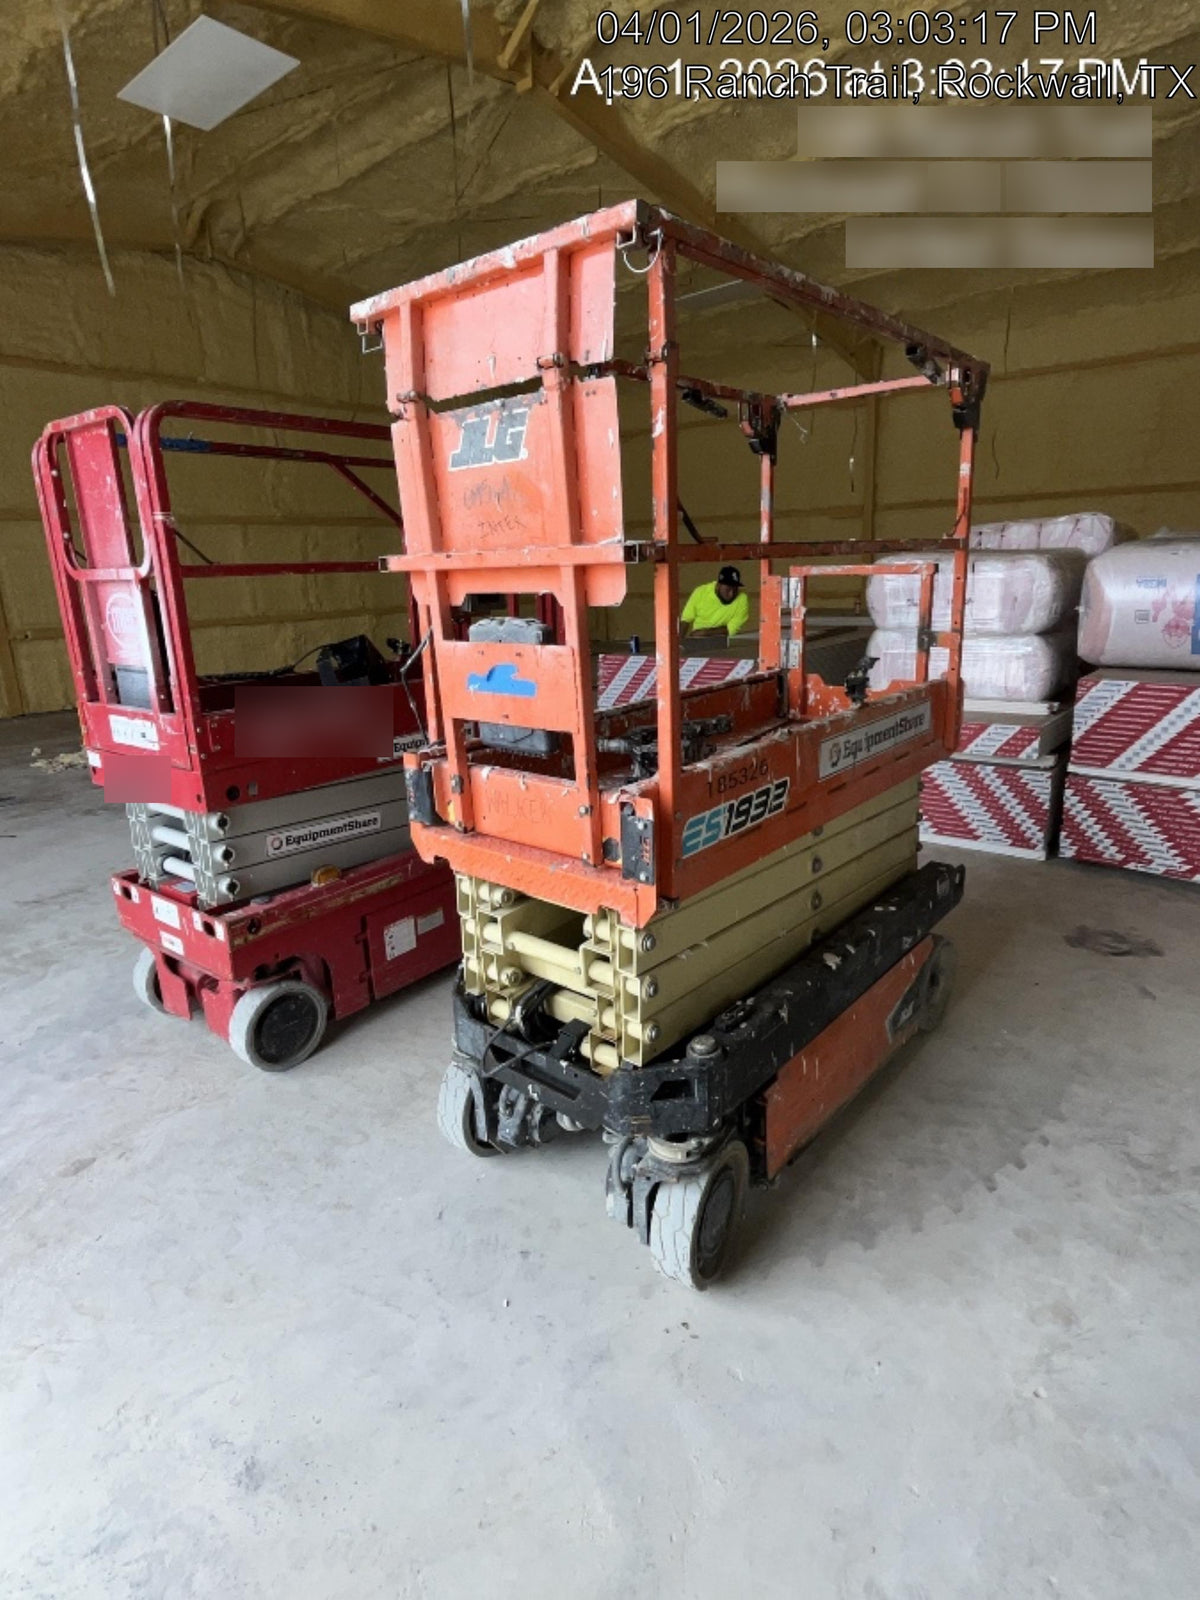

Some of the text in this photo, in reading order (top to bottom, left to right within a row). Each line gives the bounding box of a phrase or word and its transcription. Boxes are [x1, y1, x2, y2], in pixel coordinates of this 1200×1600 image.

[707, 761, 769, 799] 185326
[285, 816, 379, 847] EquipmentShare
[682, 777, 790, 859] ES1932
